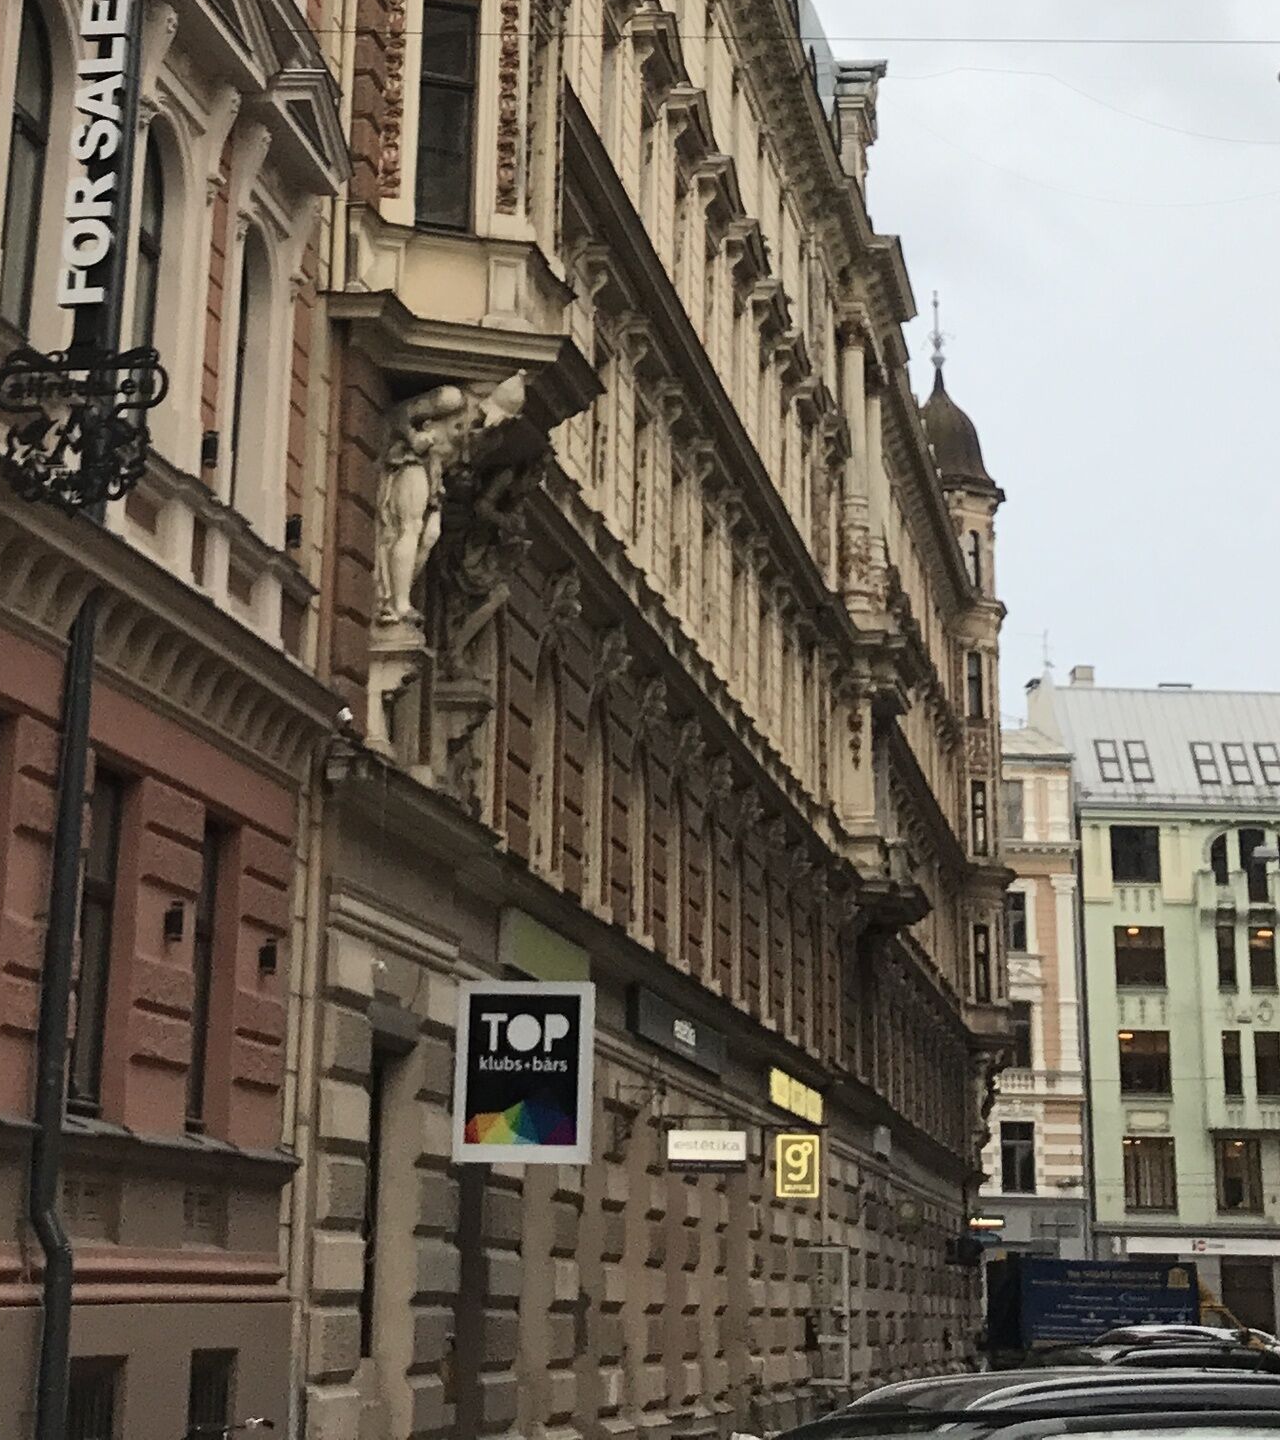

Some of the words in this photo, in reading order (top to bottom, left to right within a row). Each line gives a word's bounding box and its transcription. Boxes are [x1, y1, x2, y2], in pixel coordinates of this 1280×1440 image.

[57, 171, 116, 307] FOR
[480, 1013, 570, 1052] TOP
[479, 1054, 523, 1072] klubs
